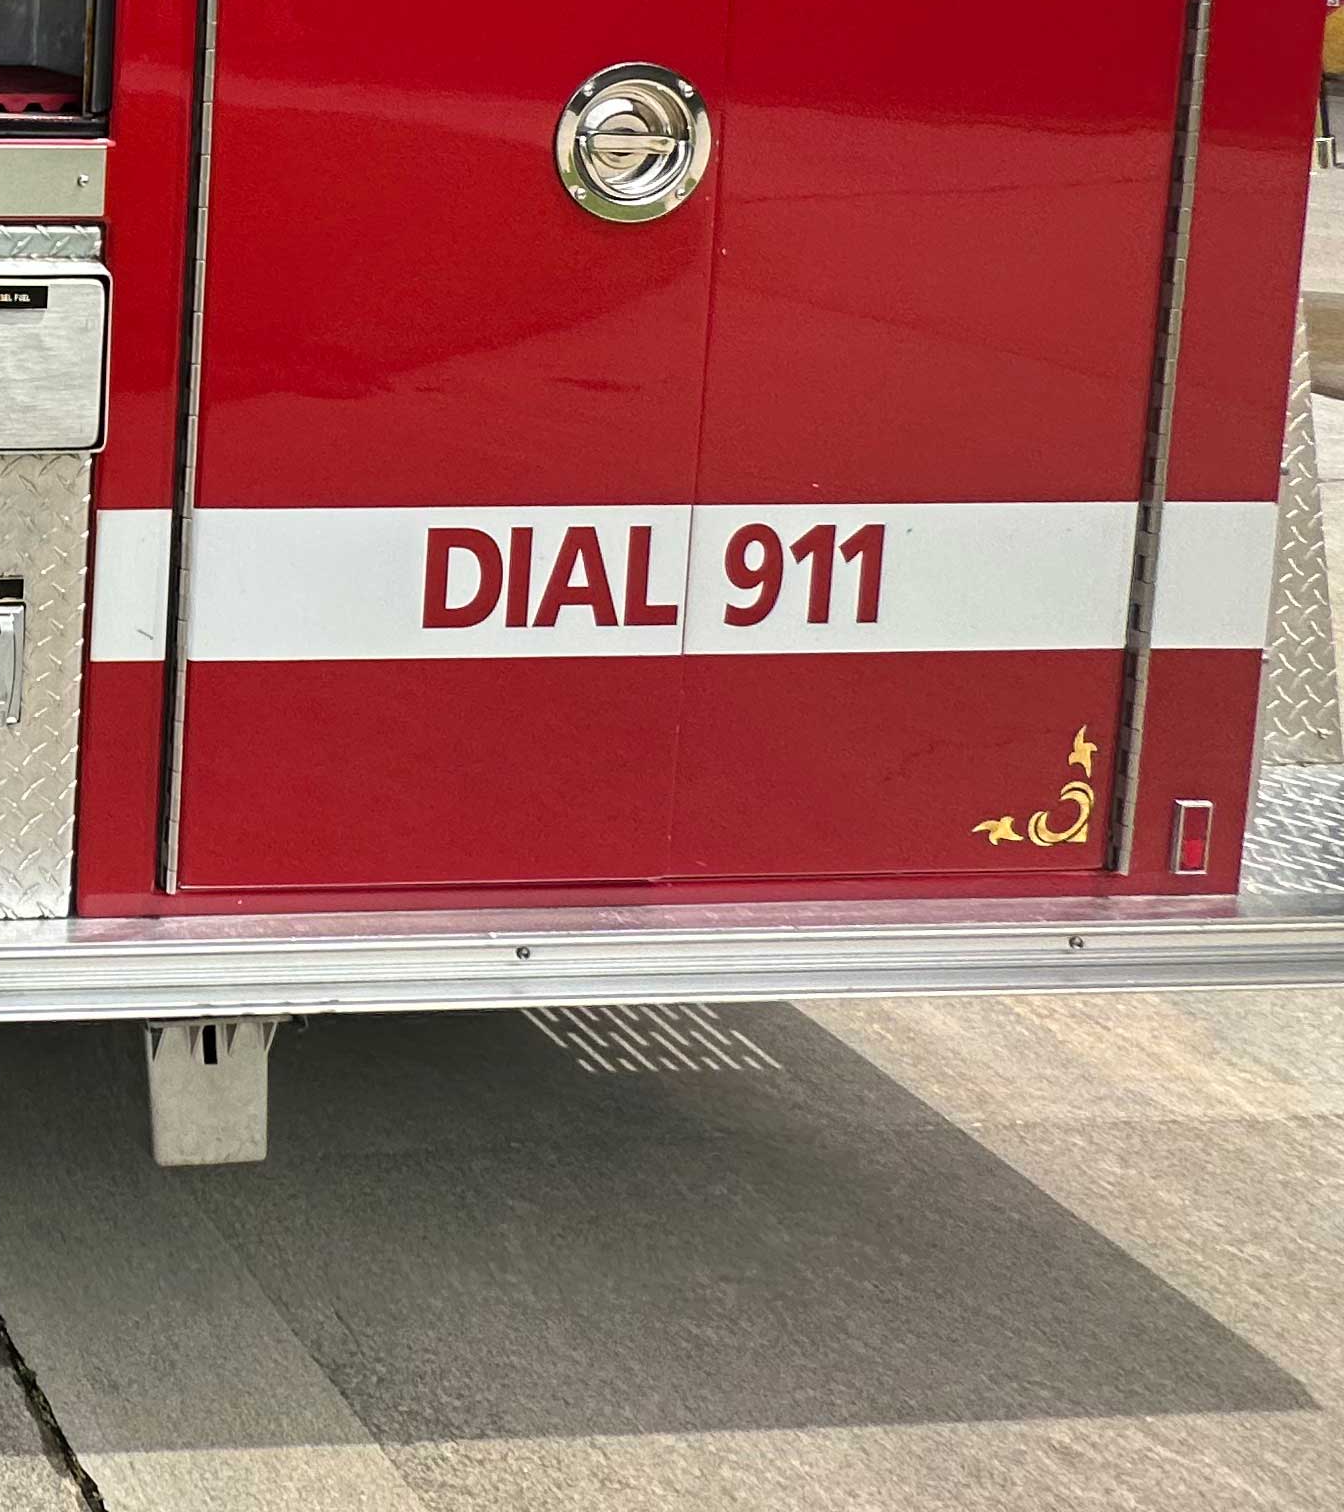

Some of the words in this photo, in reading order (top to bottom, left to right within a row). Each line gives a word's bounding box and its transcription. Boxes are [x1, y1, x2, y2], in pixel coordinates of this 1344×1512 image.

[14, 293, 31, 302] FUEL
[422, 525, 678, 629] DIAL
[723, 522, 886, 626] 911
